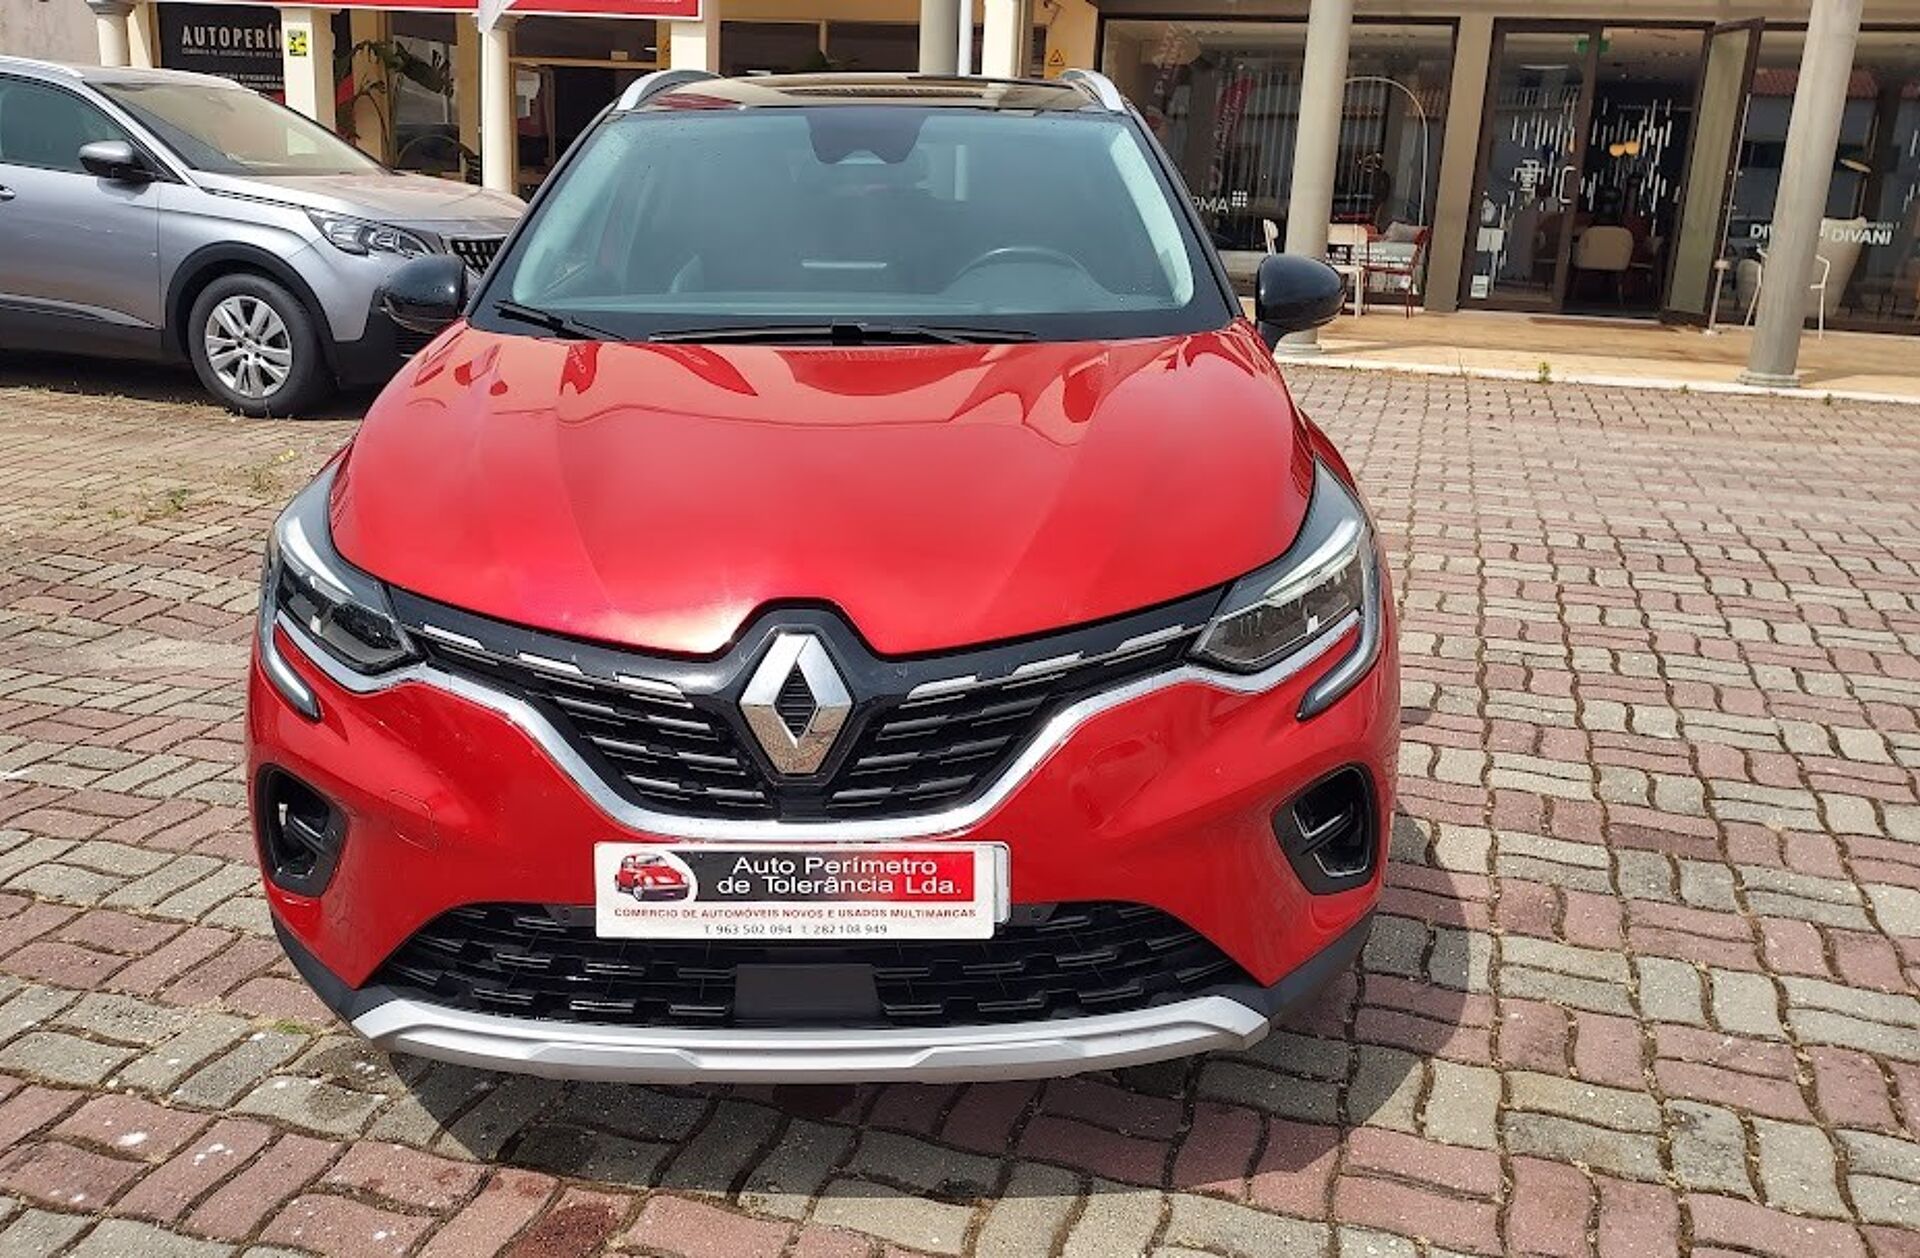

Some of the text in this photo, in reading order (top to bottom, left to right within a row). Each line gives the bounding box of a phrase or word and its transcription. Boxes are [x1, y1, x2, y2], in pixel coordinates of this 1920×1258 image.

[1831, 229, 1893, 245] DIVANI
[732, 856, 937, 875] Auto Perímetro
[716, 875, 962, 894] de Tolerância Lda.
[682, 908, 698, 918] DE
[783, 908, 823, 918] NOVOS
[827, 908, 835, 918] E
[838, 908, 887, 918] USADOS
[890, 908, 977, 918] MULTIMARCAS
[716, 924, 739, 935] 963
[743, 924, 765, 935] 502
